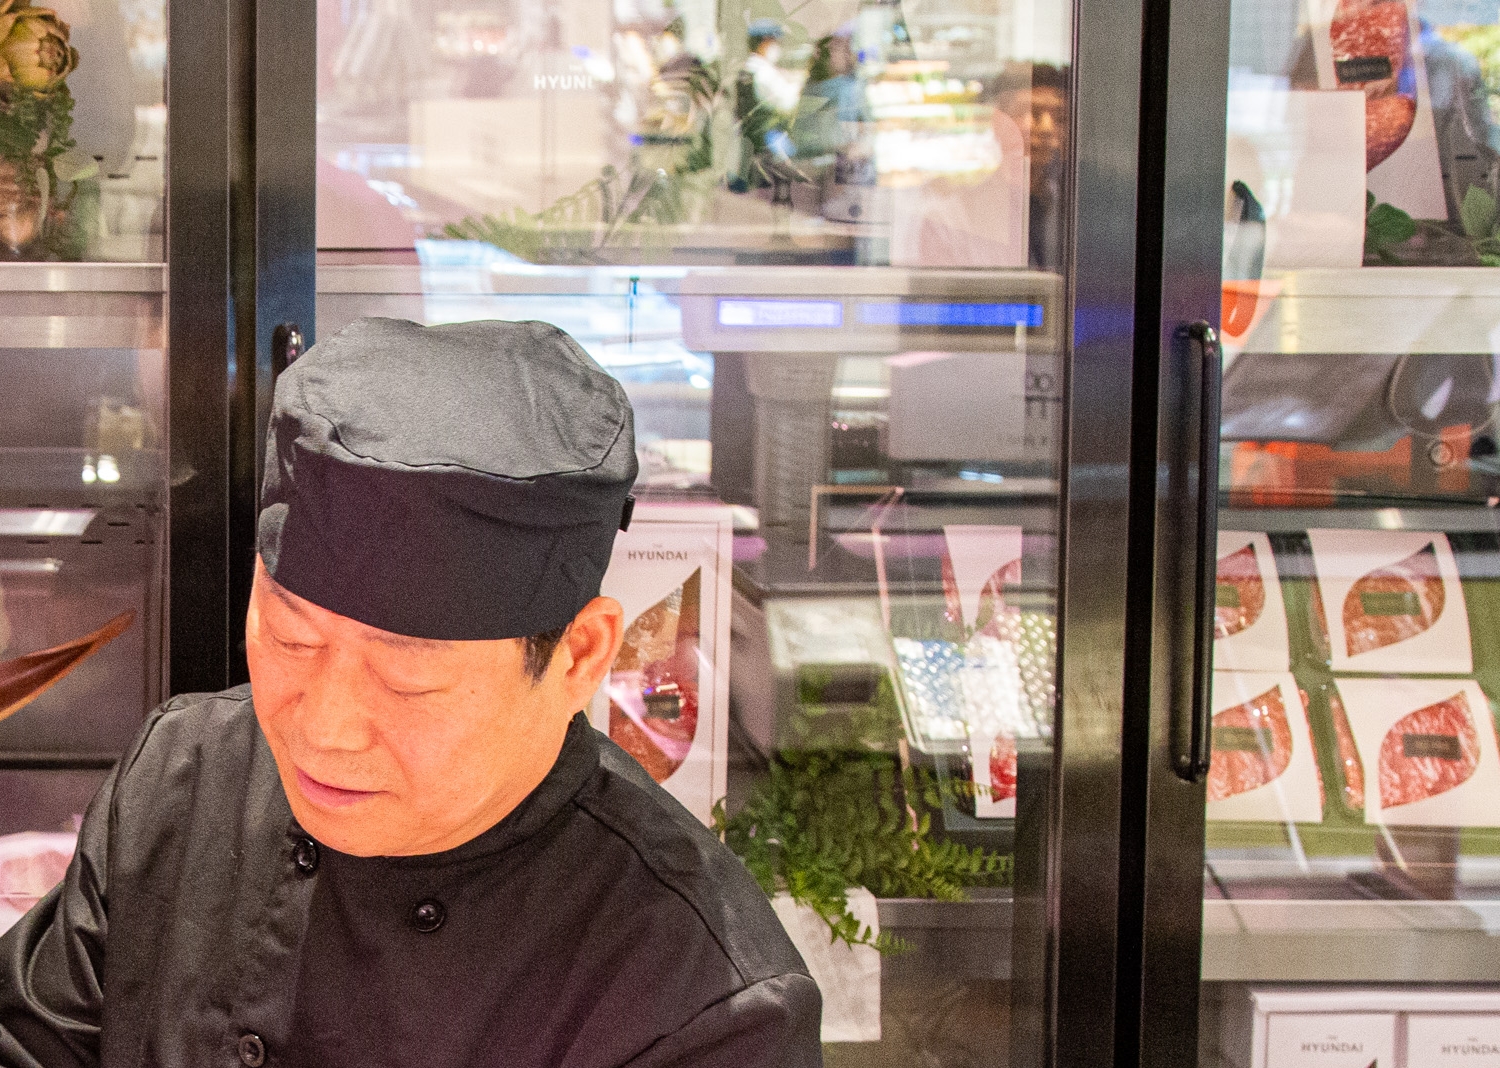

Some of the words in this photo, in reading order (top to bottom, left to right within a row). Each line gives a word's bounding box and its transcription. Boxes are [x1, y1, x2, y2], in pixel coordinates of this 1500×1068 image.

[627, 550, 688, 560] HYUNDAI
[1301, 1042, 1363, 1053] HYUNDAI
[1441, 1043, 1500, 1055] HYUNDA
